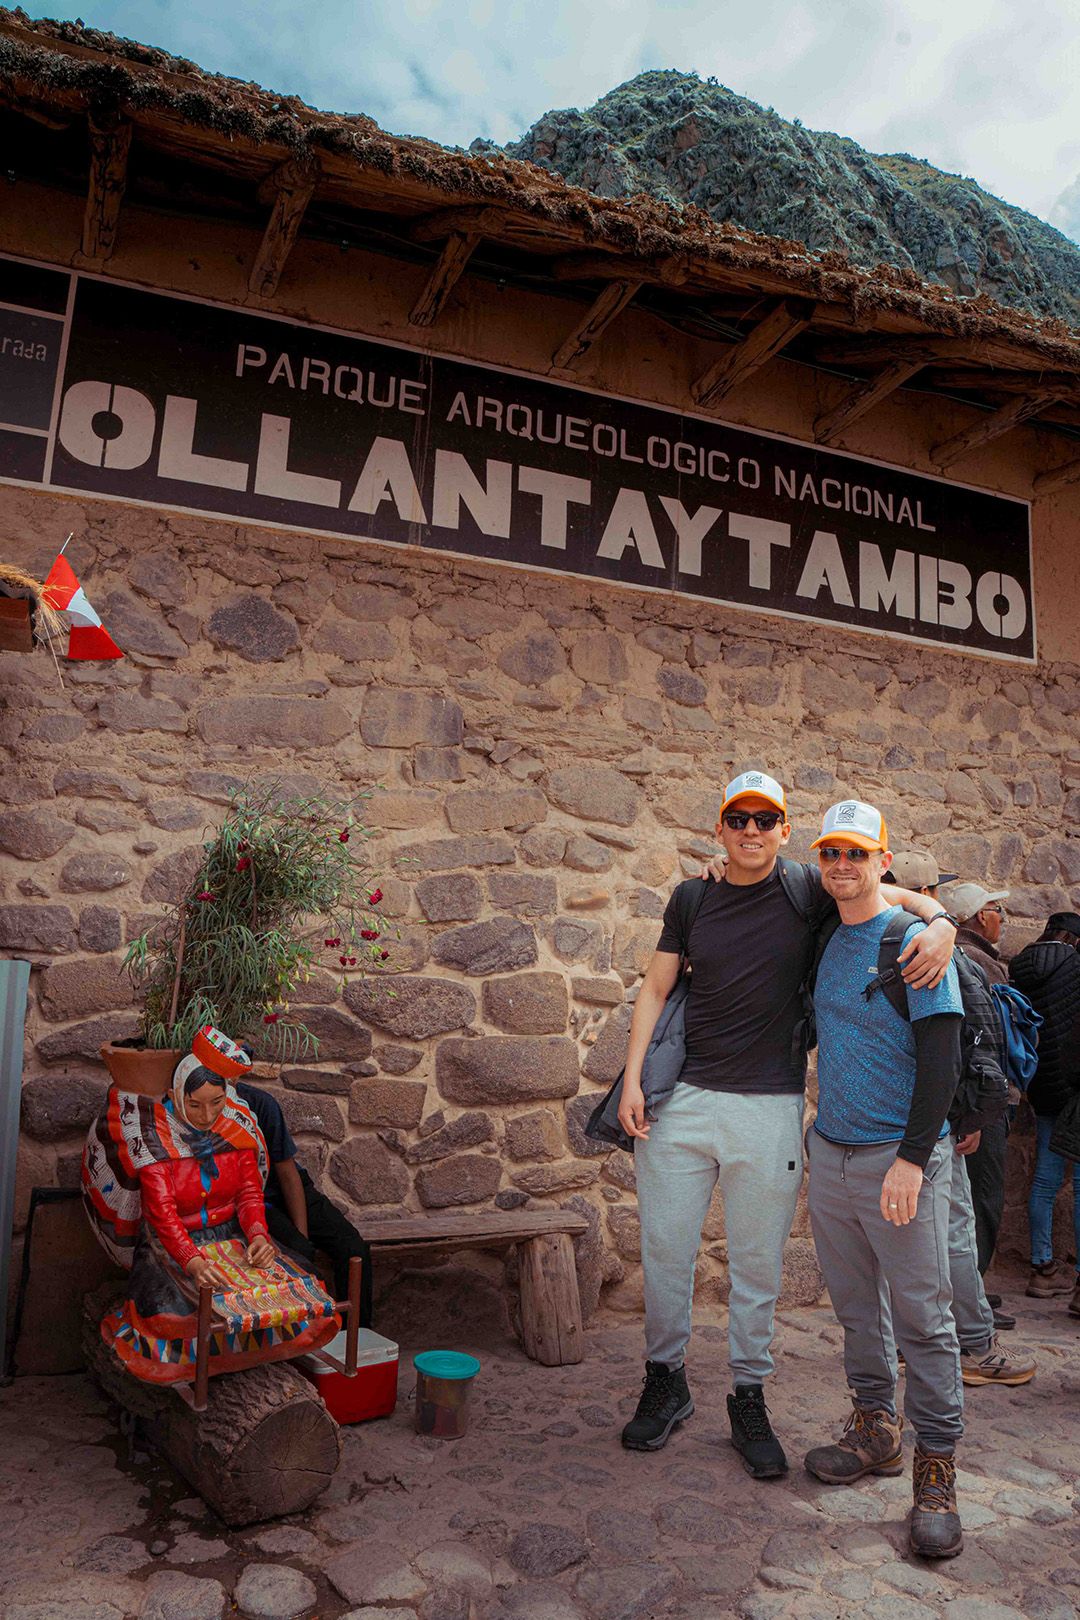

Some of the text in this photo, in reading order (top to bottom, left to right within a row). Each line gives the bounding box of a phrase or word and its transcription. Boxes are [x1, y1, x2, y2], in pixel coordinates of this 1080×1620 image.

[58, 380, 1027, 640] OLLANTAYTAMBO
[236, 343, 936, 533] PARQUE ARQUEOLOGICO NACIONAL
